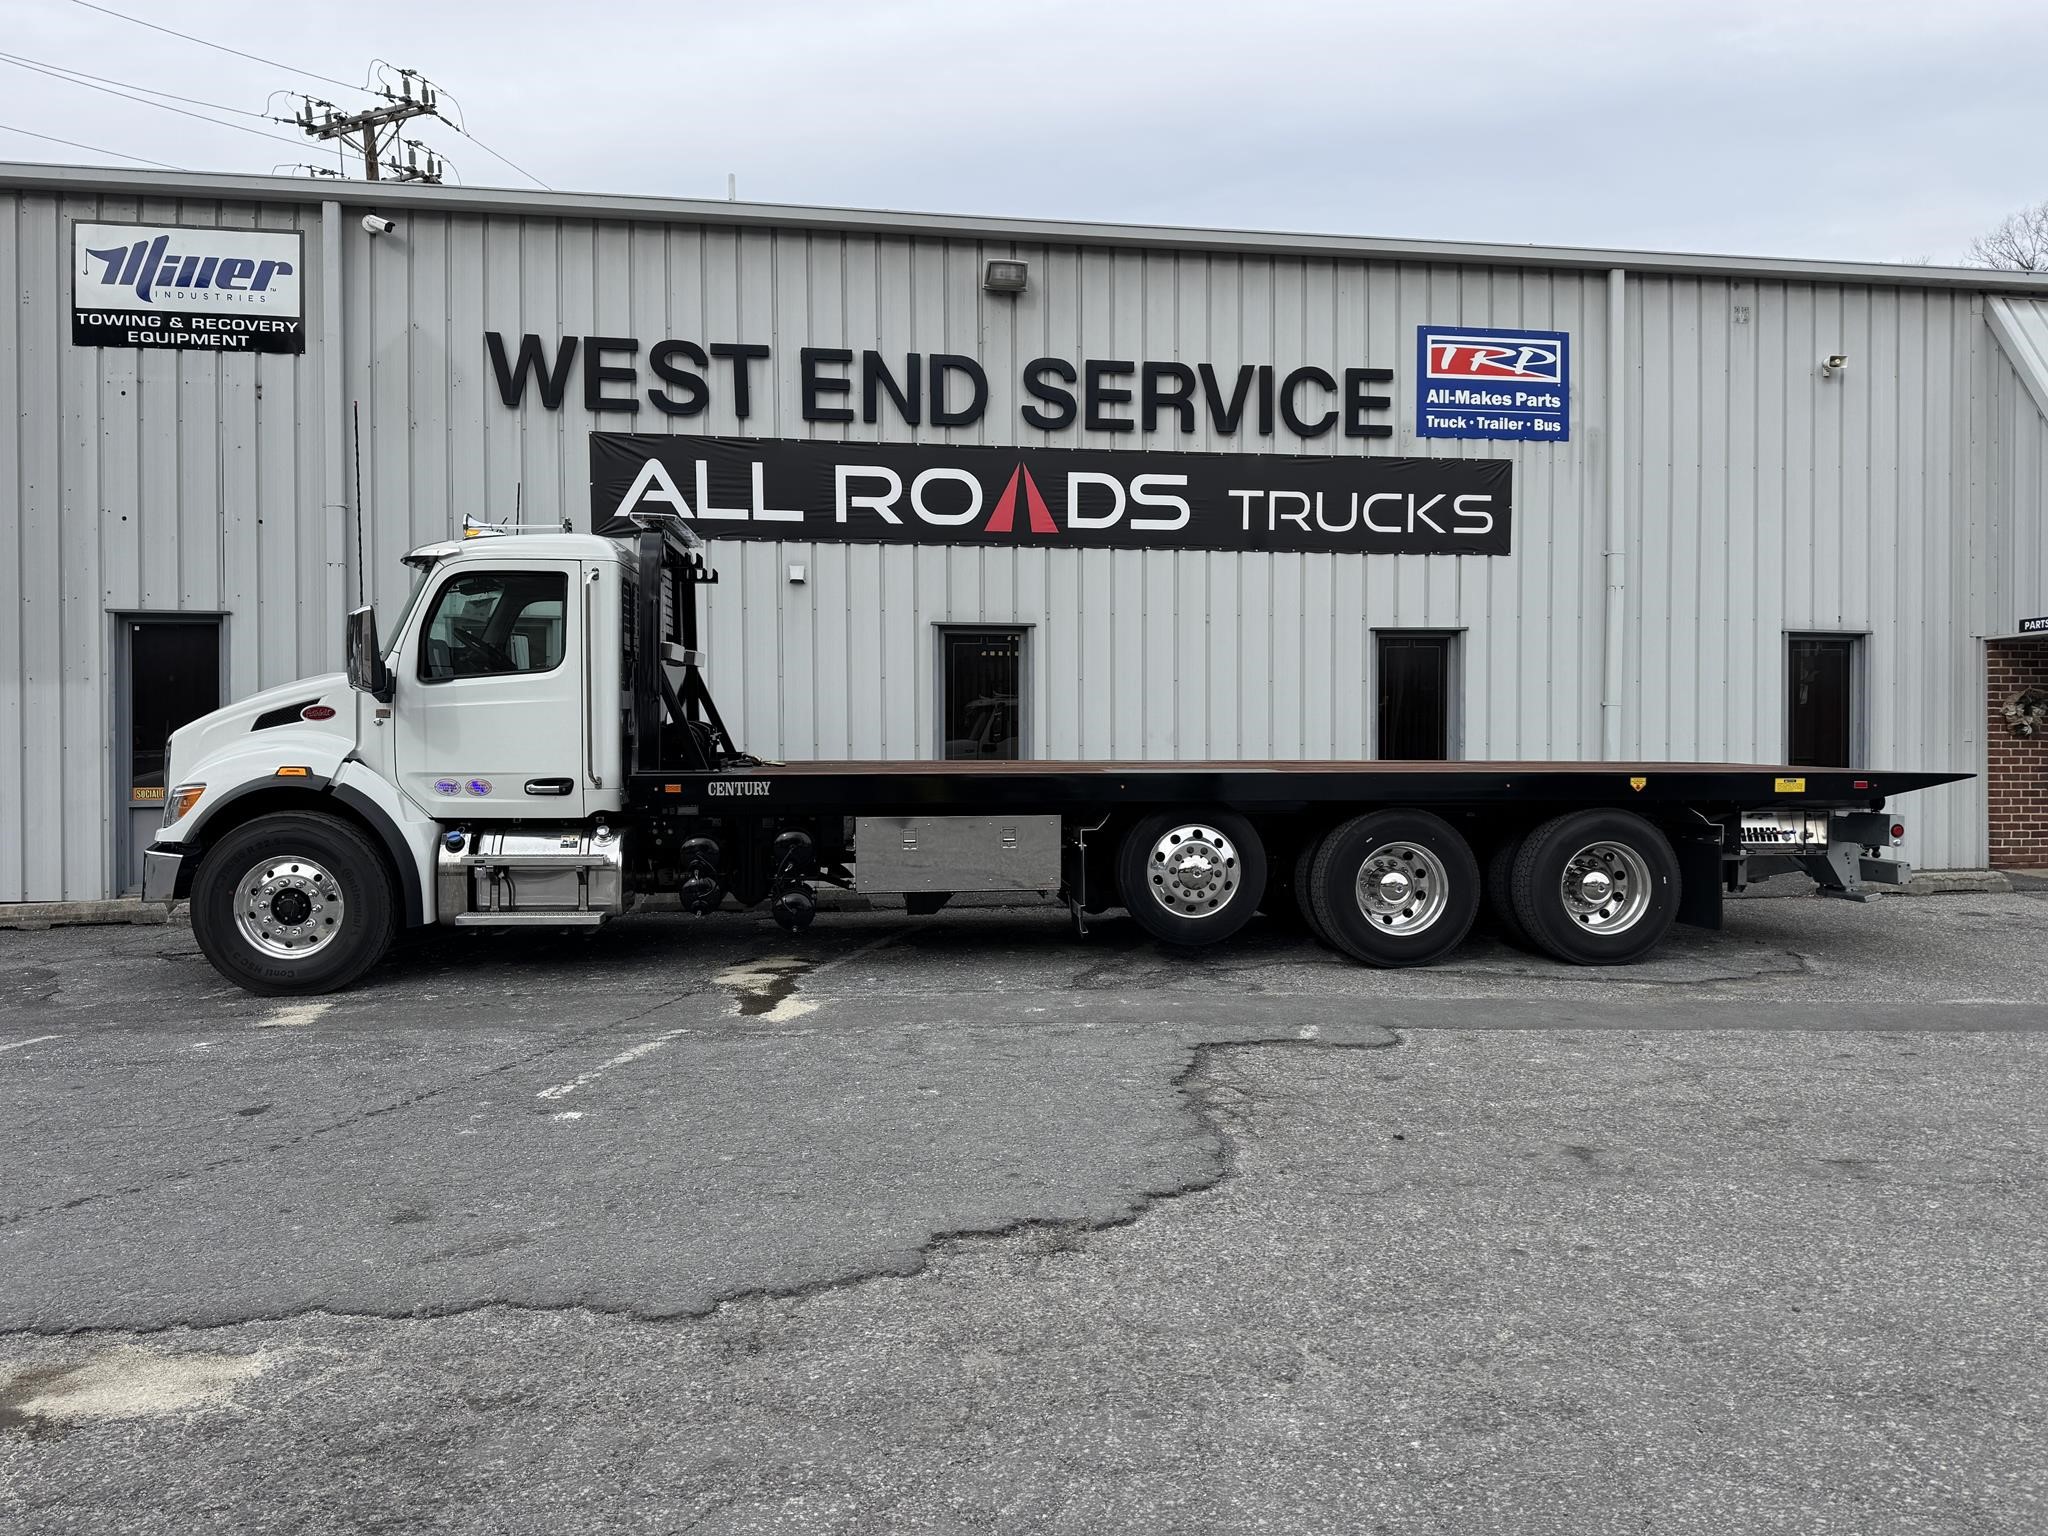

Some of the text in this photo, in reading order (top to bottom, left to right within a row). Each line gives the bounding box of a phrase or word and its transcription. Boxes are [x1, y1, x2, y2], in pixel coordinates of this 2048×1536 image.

[86, 234, 294, 304] Miller
[155, 290, 266, 303] INDUSTRIES
[77, 313, 298, 333] TOWING & RECOVERY
[128, 331, 250, 347] EQUIPMENT
[1432, 344, 1557, 375] TRP
[485, 331, 1395, 438] WEST END SERVICE
[1427, 389, 1561, 408] All-Makes Parts
[1426, 415, 1561, 431] Truck Trailer Bus
[615, 457, 804, 522] ALL
[1228, 489, 1494, 536] TRUCKS
[136, 789, 159, 799] SOCIAL
[707, 781, 771, 796] CENTURY
